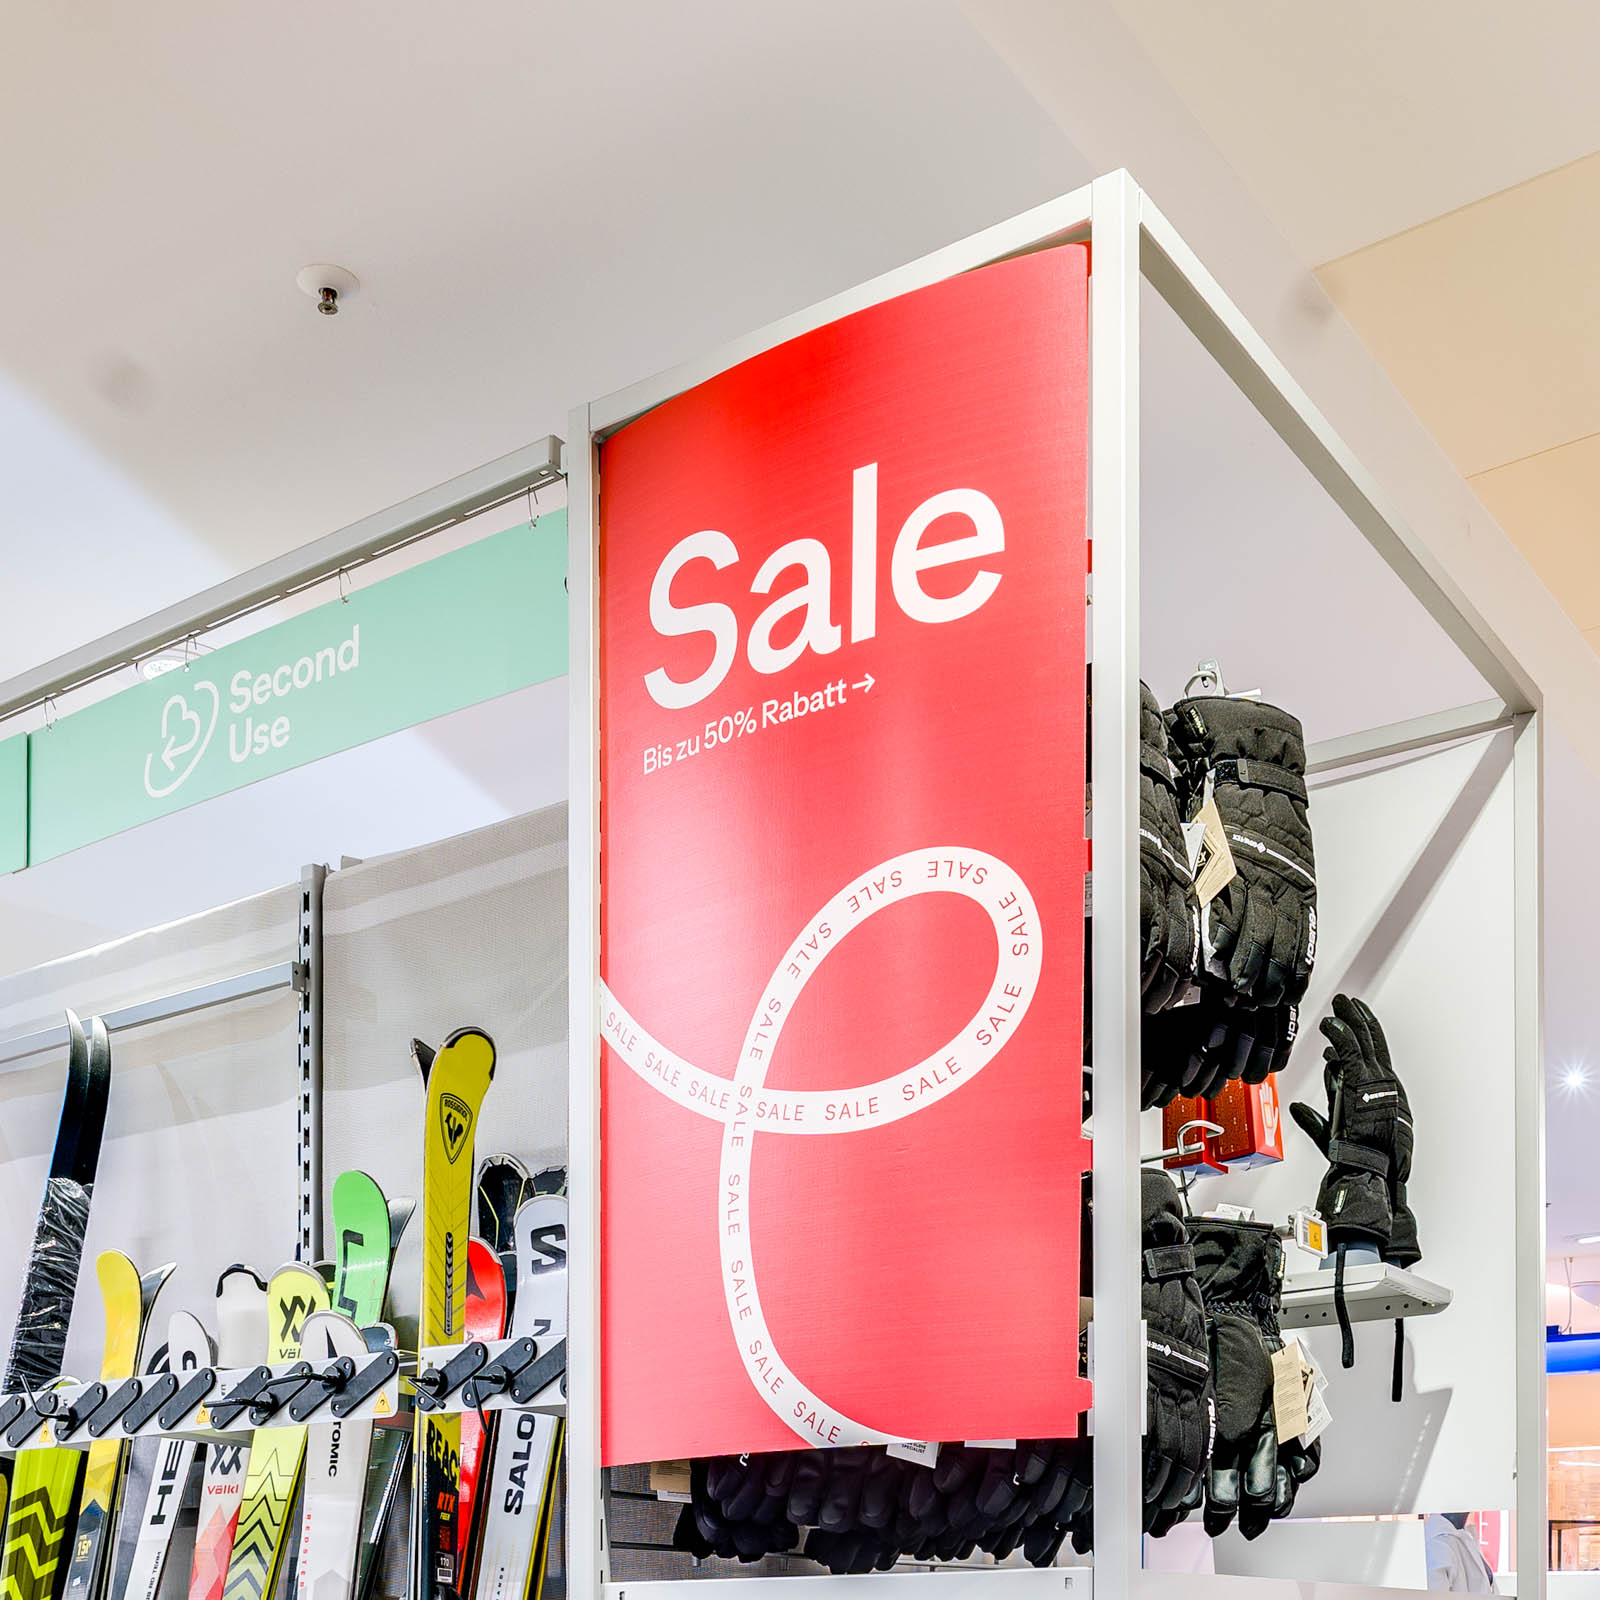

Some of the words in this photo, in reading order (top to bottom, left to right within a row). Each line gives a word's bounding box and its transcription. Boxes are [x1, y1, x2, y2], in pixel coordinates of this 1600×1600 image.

[643, 461, 1006, 710] Sale
[229, 623, 360, 714] Second
[229, 715, 291, 764] Use
[642, 744, 673, 776] Bis
[676, 732, 700, 760] zu
[703, 706, 757, 750] 50%
[762, 676, 847, 730] Rabatt
[847, 869, 903, 913] SALE
[928, 859, 988, 885] SALE
[787, 922, 831, 978] SALE
[999, 892, 1030, 956] SALE
[607, 1011, 636, 1052] SALE
[750, 998, 782, 1060] SALE
[977, 983, 1021, 1045] SALE
[645, 1051, 681, 1089] SALE
[688, 1080, 729, 1111] SALE
[902, 1057, 962, 1101] SALE
[731, 1084, 753, 1148] SALE
[757, 1101, 804, 1121] SALE
[825, 1098, 880, 1121] SALE
[729, 1175, 740, 1236] SALE
[731, 1261, 752, 1321] SALE
[279, 1348, 302, 1359] Völ
[750, 1340, 784, 1394] SALE
[329, 1421, 341, 1478] TOMIC
[793, 1402, 841, 1444] SALE
[427, 1418, 460, 1492] REAC
[504, 1414, 536, 1516] SALO
[208, 1484, 239, 1495] Völkl
[437, 1491, 456, 1513] RTX
